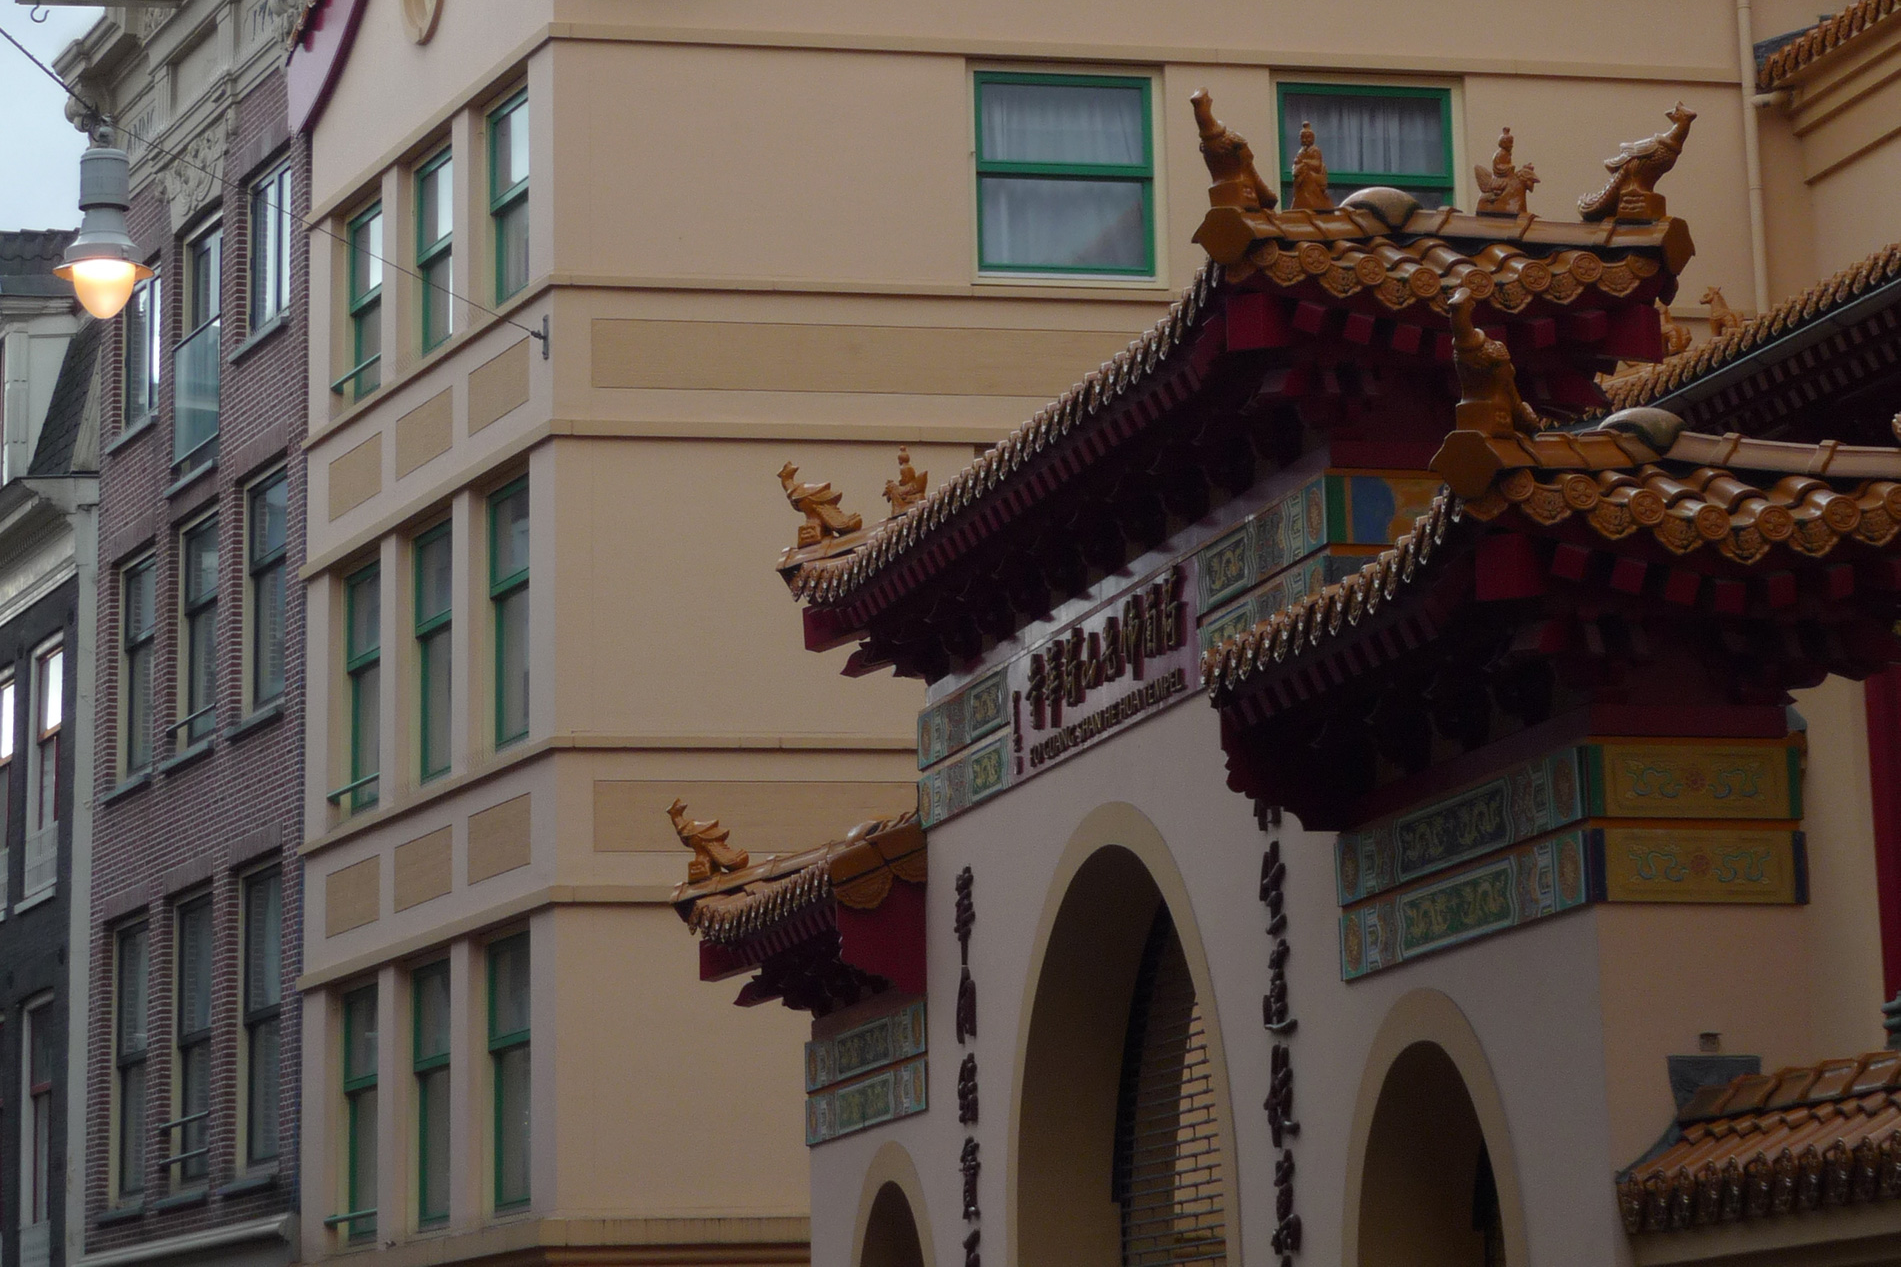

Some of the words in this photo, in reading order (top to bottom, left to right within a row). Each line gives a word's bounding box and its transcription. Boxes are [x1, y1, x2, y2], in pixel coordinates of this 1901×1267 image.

[1044, 724, 1078, 759] GUANG
[1076, 709, 1104, 743] SHAN
[1103, 700, 1121, 728] HE
[1119, 688, 1143, 720] HUA
[1144, 668, 1187, 707] TEMPEL
